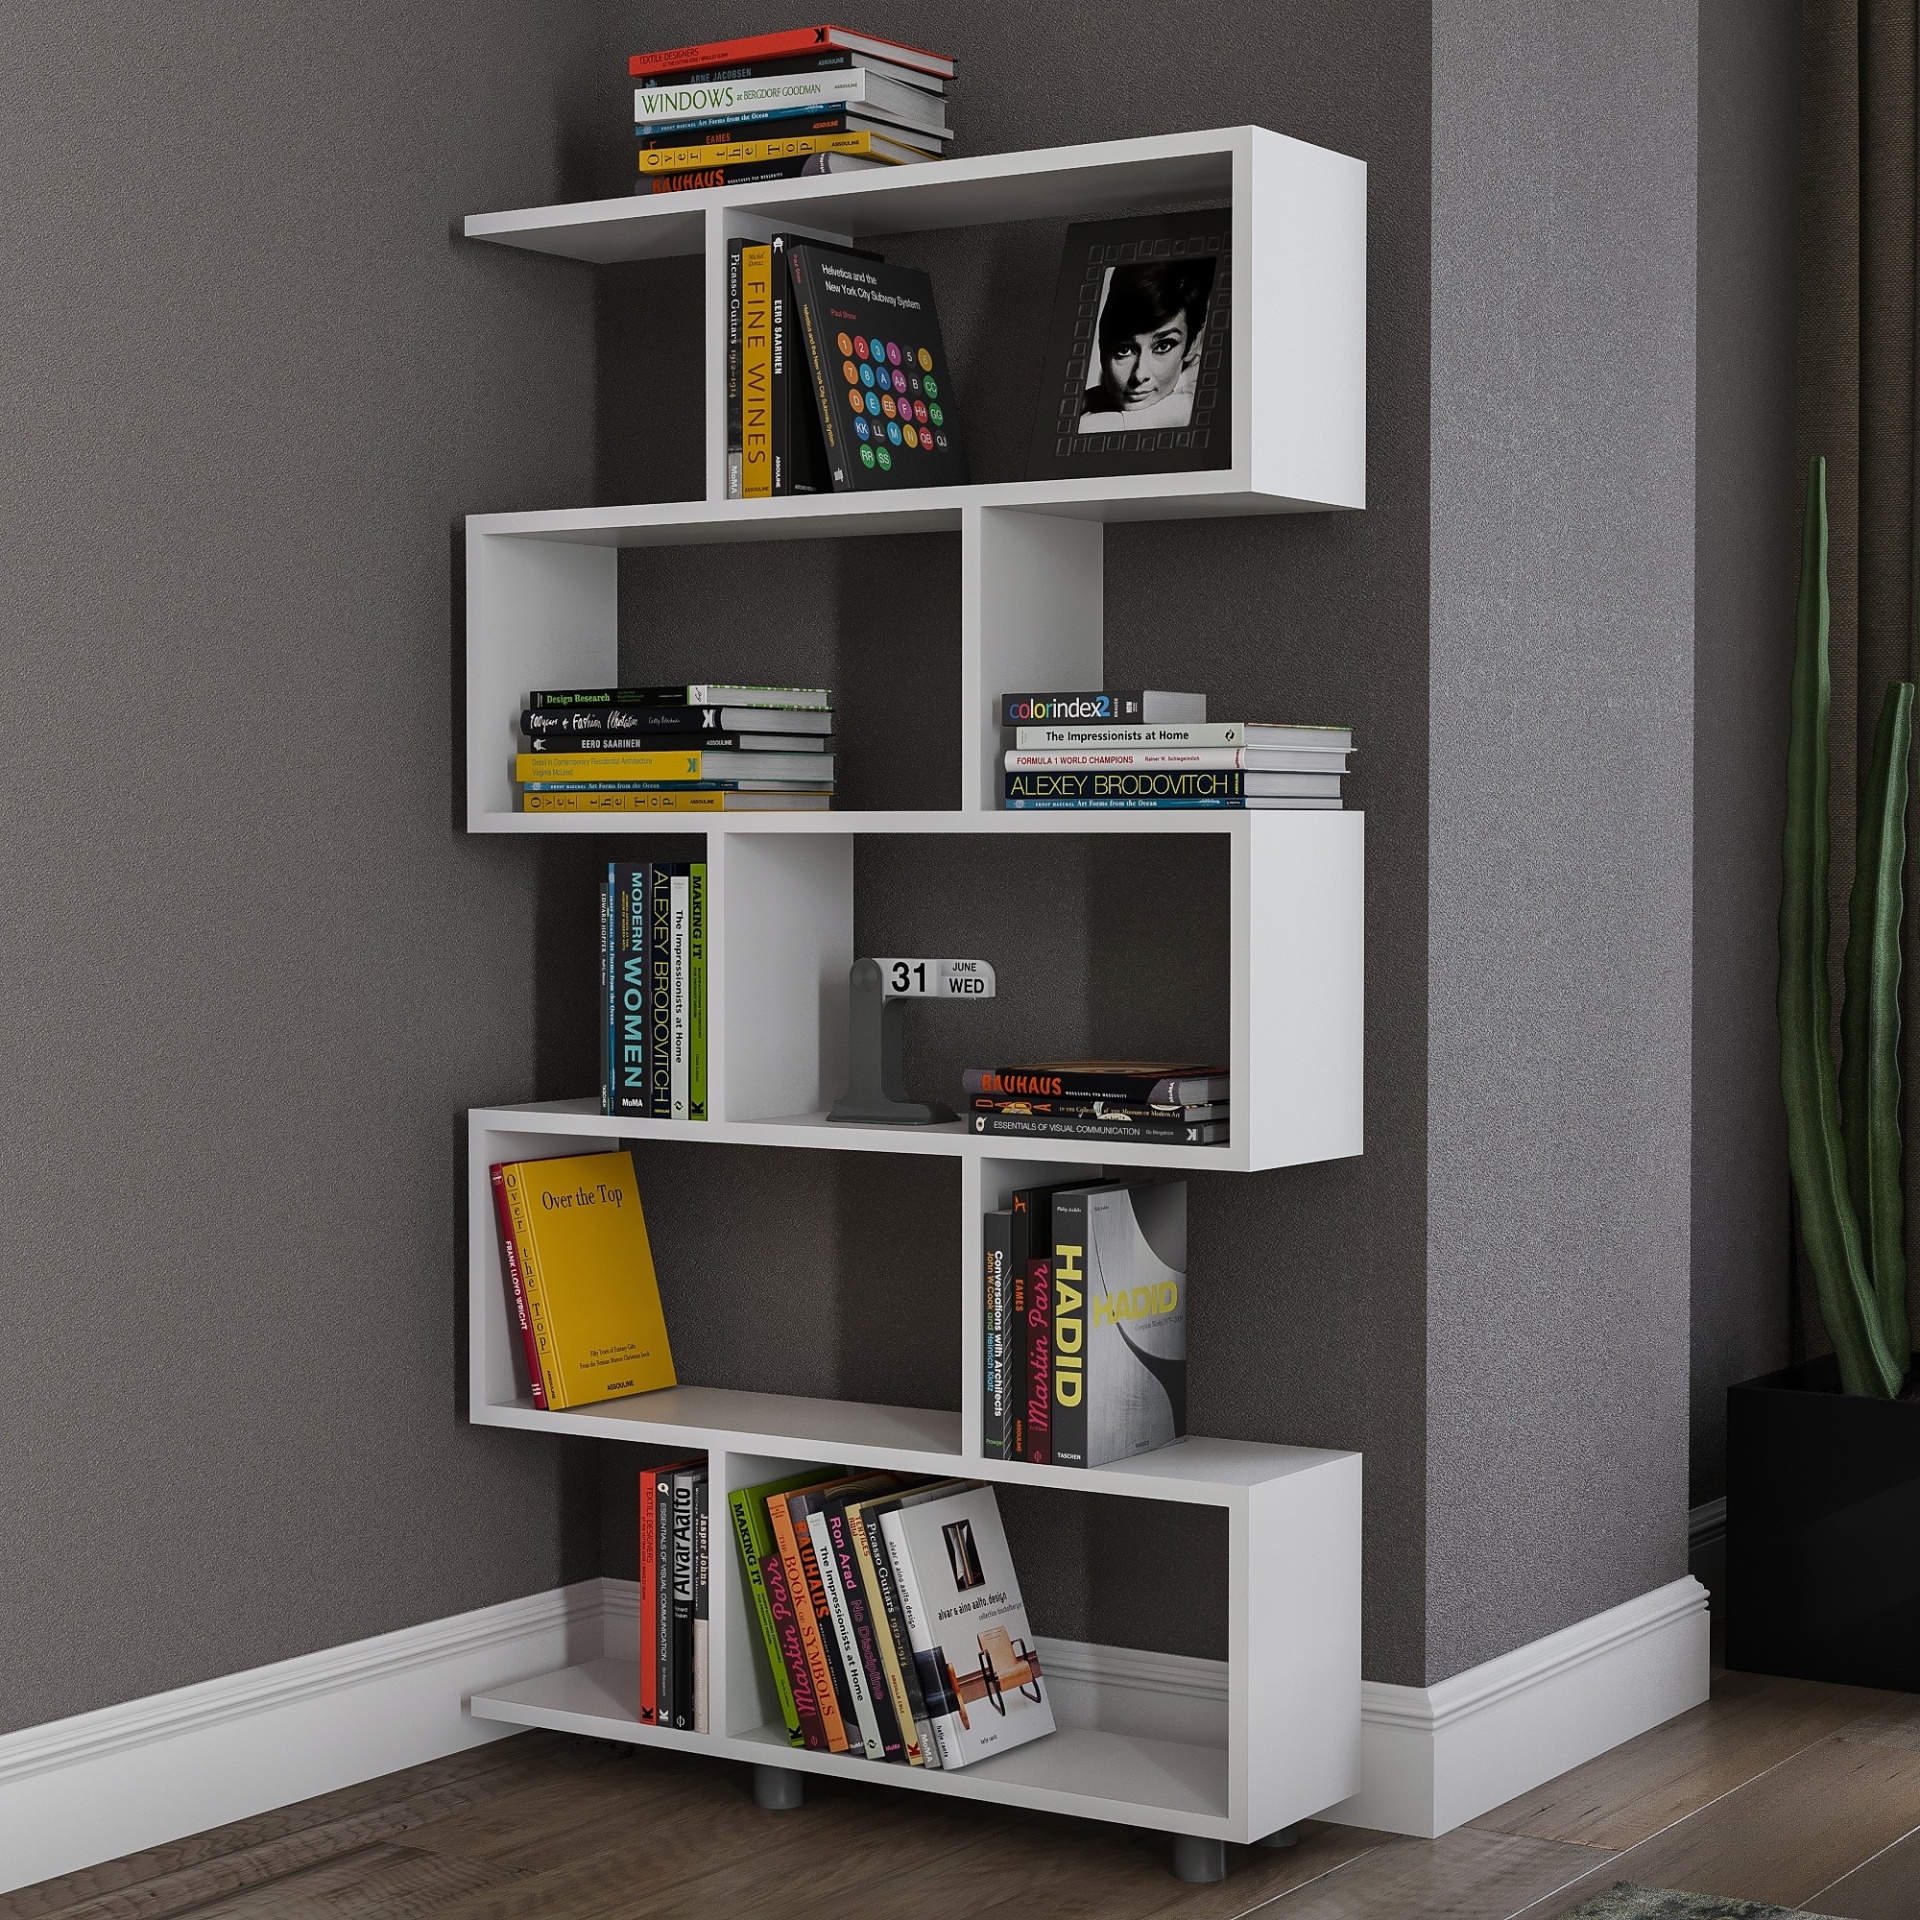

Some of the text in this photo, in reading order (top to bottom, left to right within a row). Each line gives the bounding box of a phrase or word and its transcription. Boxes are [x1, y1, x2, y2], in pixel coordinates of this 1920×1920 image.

[639, 48, 698, 64] TEXTILE DESIGNERS
[691, 68, 752, 84] ARNE JACOBSEN
[641, 84, 821, 114] WINDOWS at BERGDORF GOODMAN
[708, 118, 725, 126] Forms
[706, 133, 731, 144] EAMES
[832, 140, 860, 148] ASSOULINE
[647, 143, 813, 166] Over the Top
[652, 169, 724, 194] BAUHAUS
[822, 264, 877, 284] Helvetica and the
[731, 254, 740, 344] Picasso Guitars
[825, 280, 921, 310] New York City Subway System
[774, 326, 782, 375] SAARINEN
[747, 282, 766, 464] FINE WINES
[546, 695, 572, 705] Design
[575, 693, 610, 702] Research
[1009, 695, 1110, 720] colorindex2
[582, 739, 641, 748] EERO SAARINEN
[1046, 730, 1189, 743] The Impressionists at Home
[533, 769, 551, 777] Virginia
[554, 758, 589, 766] Contemporary
[1017, 757, 1052, 765] FORMULA
[1060, 756, 1087, 764] WORLD
[1089, 756, 1133, 764] CHAMPIONS
[1011, 774, 1228, 796] ALEXEY BRODOVITCH
[531, 797, 674, 808] Over the Top
[693, 876, 702, 939] MAKING
[693, 944, 702, 959] IT
[624, 872, 642, 1087] MODERN WOMEN
[674, 934, 683, 1013] Impressionists
[892, 962, 925, 992] 31
[952, 962, 977, 972] JUNE
[654, 870, 669, 1102] ALEXEY BRODOVITCH
[949, 978, 985, 994] WED
[676, 1018, 682, 1028] at
[981, 1073, 1062, 1095] BAUHAUS
[622, 1098, 643, 1107] MoMA
[975, 1099, 1051, 1112] DADA
[994, 1120, 1140, 1136] ESSENTIALS OF VISUAL COMMUNICATION
[542, 1184, 623, 1212] Over the Top
[507, 1174, 546, 1351] Over the Top
[506, 1241, 527, 1330] FRANK LLOYD WRIGHT
[1015, 1279, 1024, 1312] EAMES
[1029, 1264, 1048, 1327] Parr
[1093, 1280, 1178, 1328] HADID
[994, 1251, 1003, 1417] Conversations with Architects
[1056, 1244, 1082, 1407] HADID
[607, 1379, 635, 1391] ASSOULINE
[1028, 1335, 1048, 1428] Martin
[1057, 1451, 1081, 1461] TASCHEN
[699, 1514, 707, 1550] Jasper
[734, 1503, 762, 1585] MAKING IT
[661, 1552, 666, 1563] OF
[794, 1521, 830, 1618] BAUHAUS
[820, 1546, 830, 1567] The
[867, 1523, 895, 1613] Picasso Guitars
[767, 1558, 792, 1621] Parr
[889, 1541, 915, 1629] alvar design
[826, 1570, 851, 1651] Impressionists
[830, 1517, 883, 1700] Ron Arad No Discipline
[938, 1608, 953, 1620] alvar
[959, 1602, 971, 1613] aino
[989, 1592, 1008, 1604] design
[978, 1610, 997, 1621] collection
[779, 1534, 787, 1553] THE
[784, 1556, 806, 1608] BOOK
[802, 1625, 835, 1716] SYMBOLS
[783, 1625, 816, 1715] Martin
[847, 1654, 855, 1666] at
[850, 1668, 863, 1702] Home
[920, 1733, 932, 1763] MoMA
